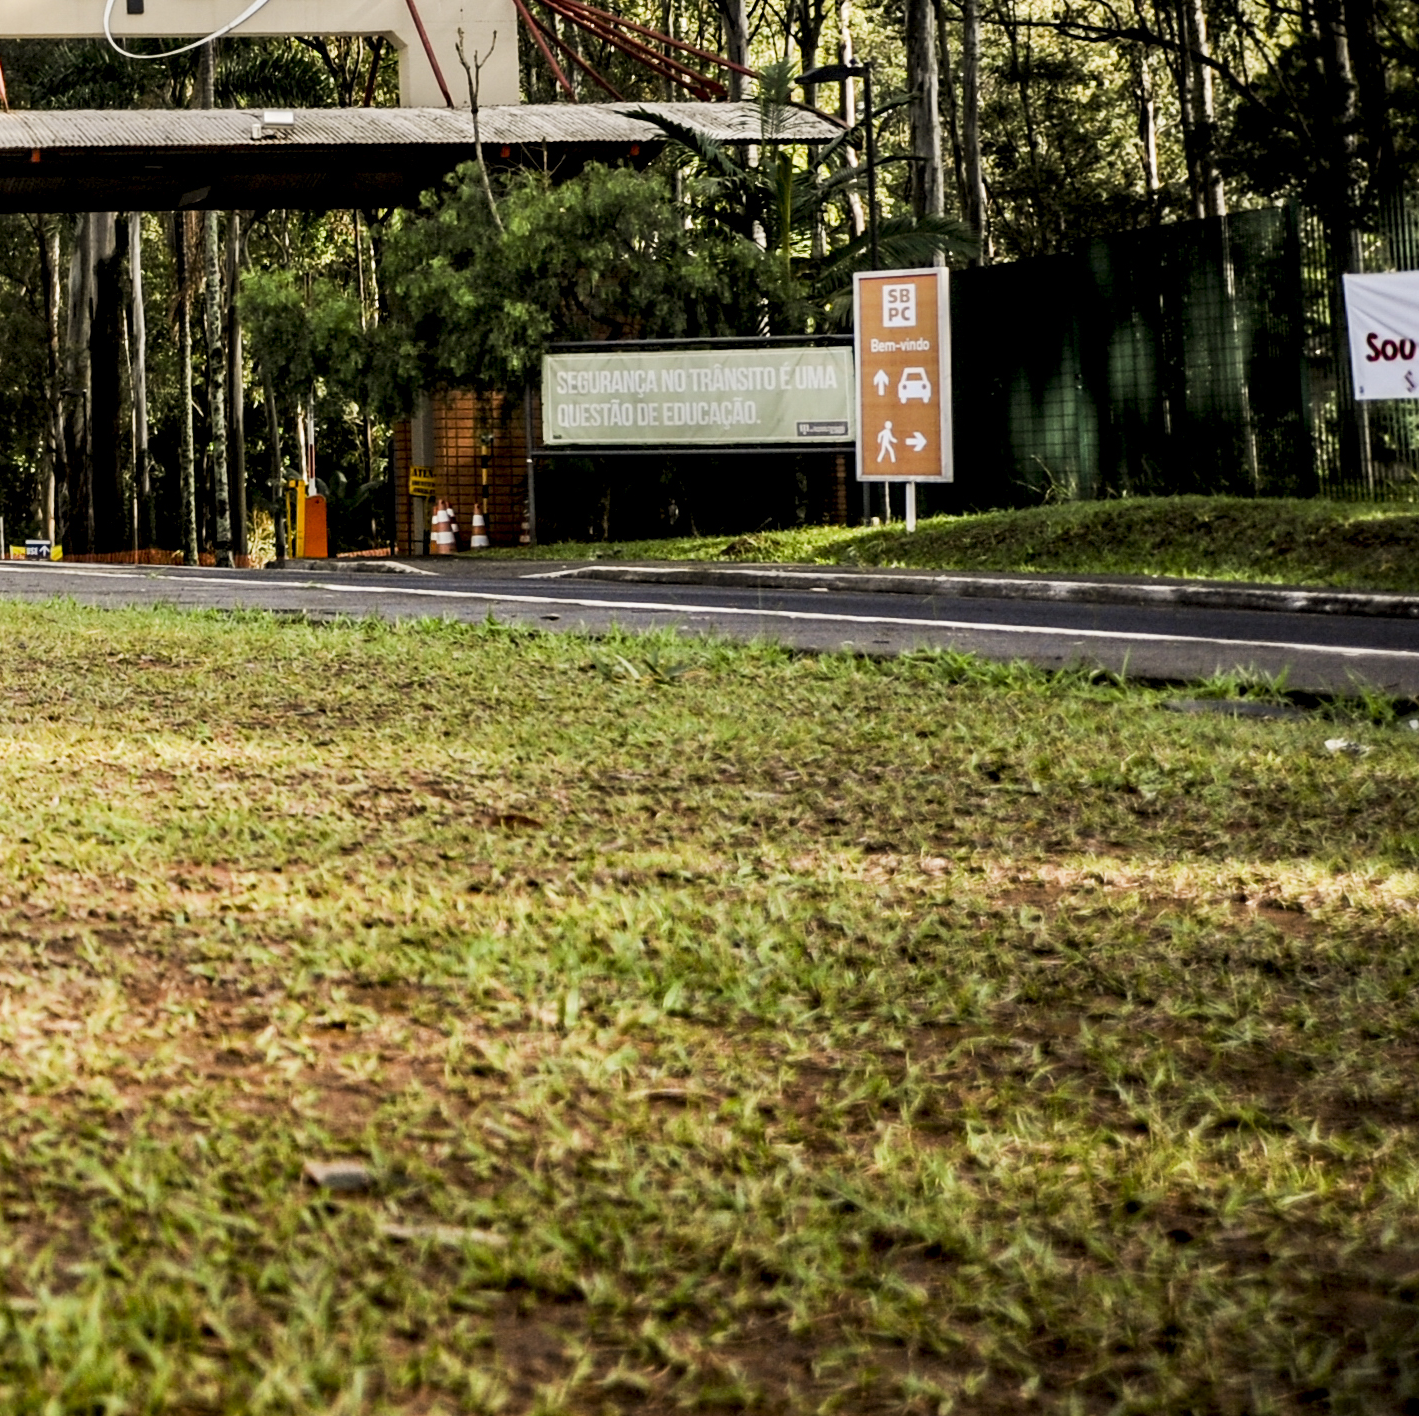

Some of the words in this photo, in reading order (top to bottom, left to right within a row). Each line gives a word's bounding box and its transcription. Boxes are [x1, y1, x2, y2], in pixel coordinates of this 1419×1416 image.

[870, 337, 931, 353] Bem-vindo
[556, 369, 659, 398] SEGURANÇA
[662, 369, 687, 393] NO
[689, 364, 776, 392] TRÂNSITO
[779, 362, 792, 390] É
[795, 365, 838, 390] UMA
[556, 399, 634, 428] QUESTÃO
[637, 402, 660, 426] DE
[663, 397, 762, 430] EDUCAÇÃO.
